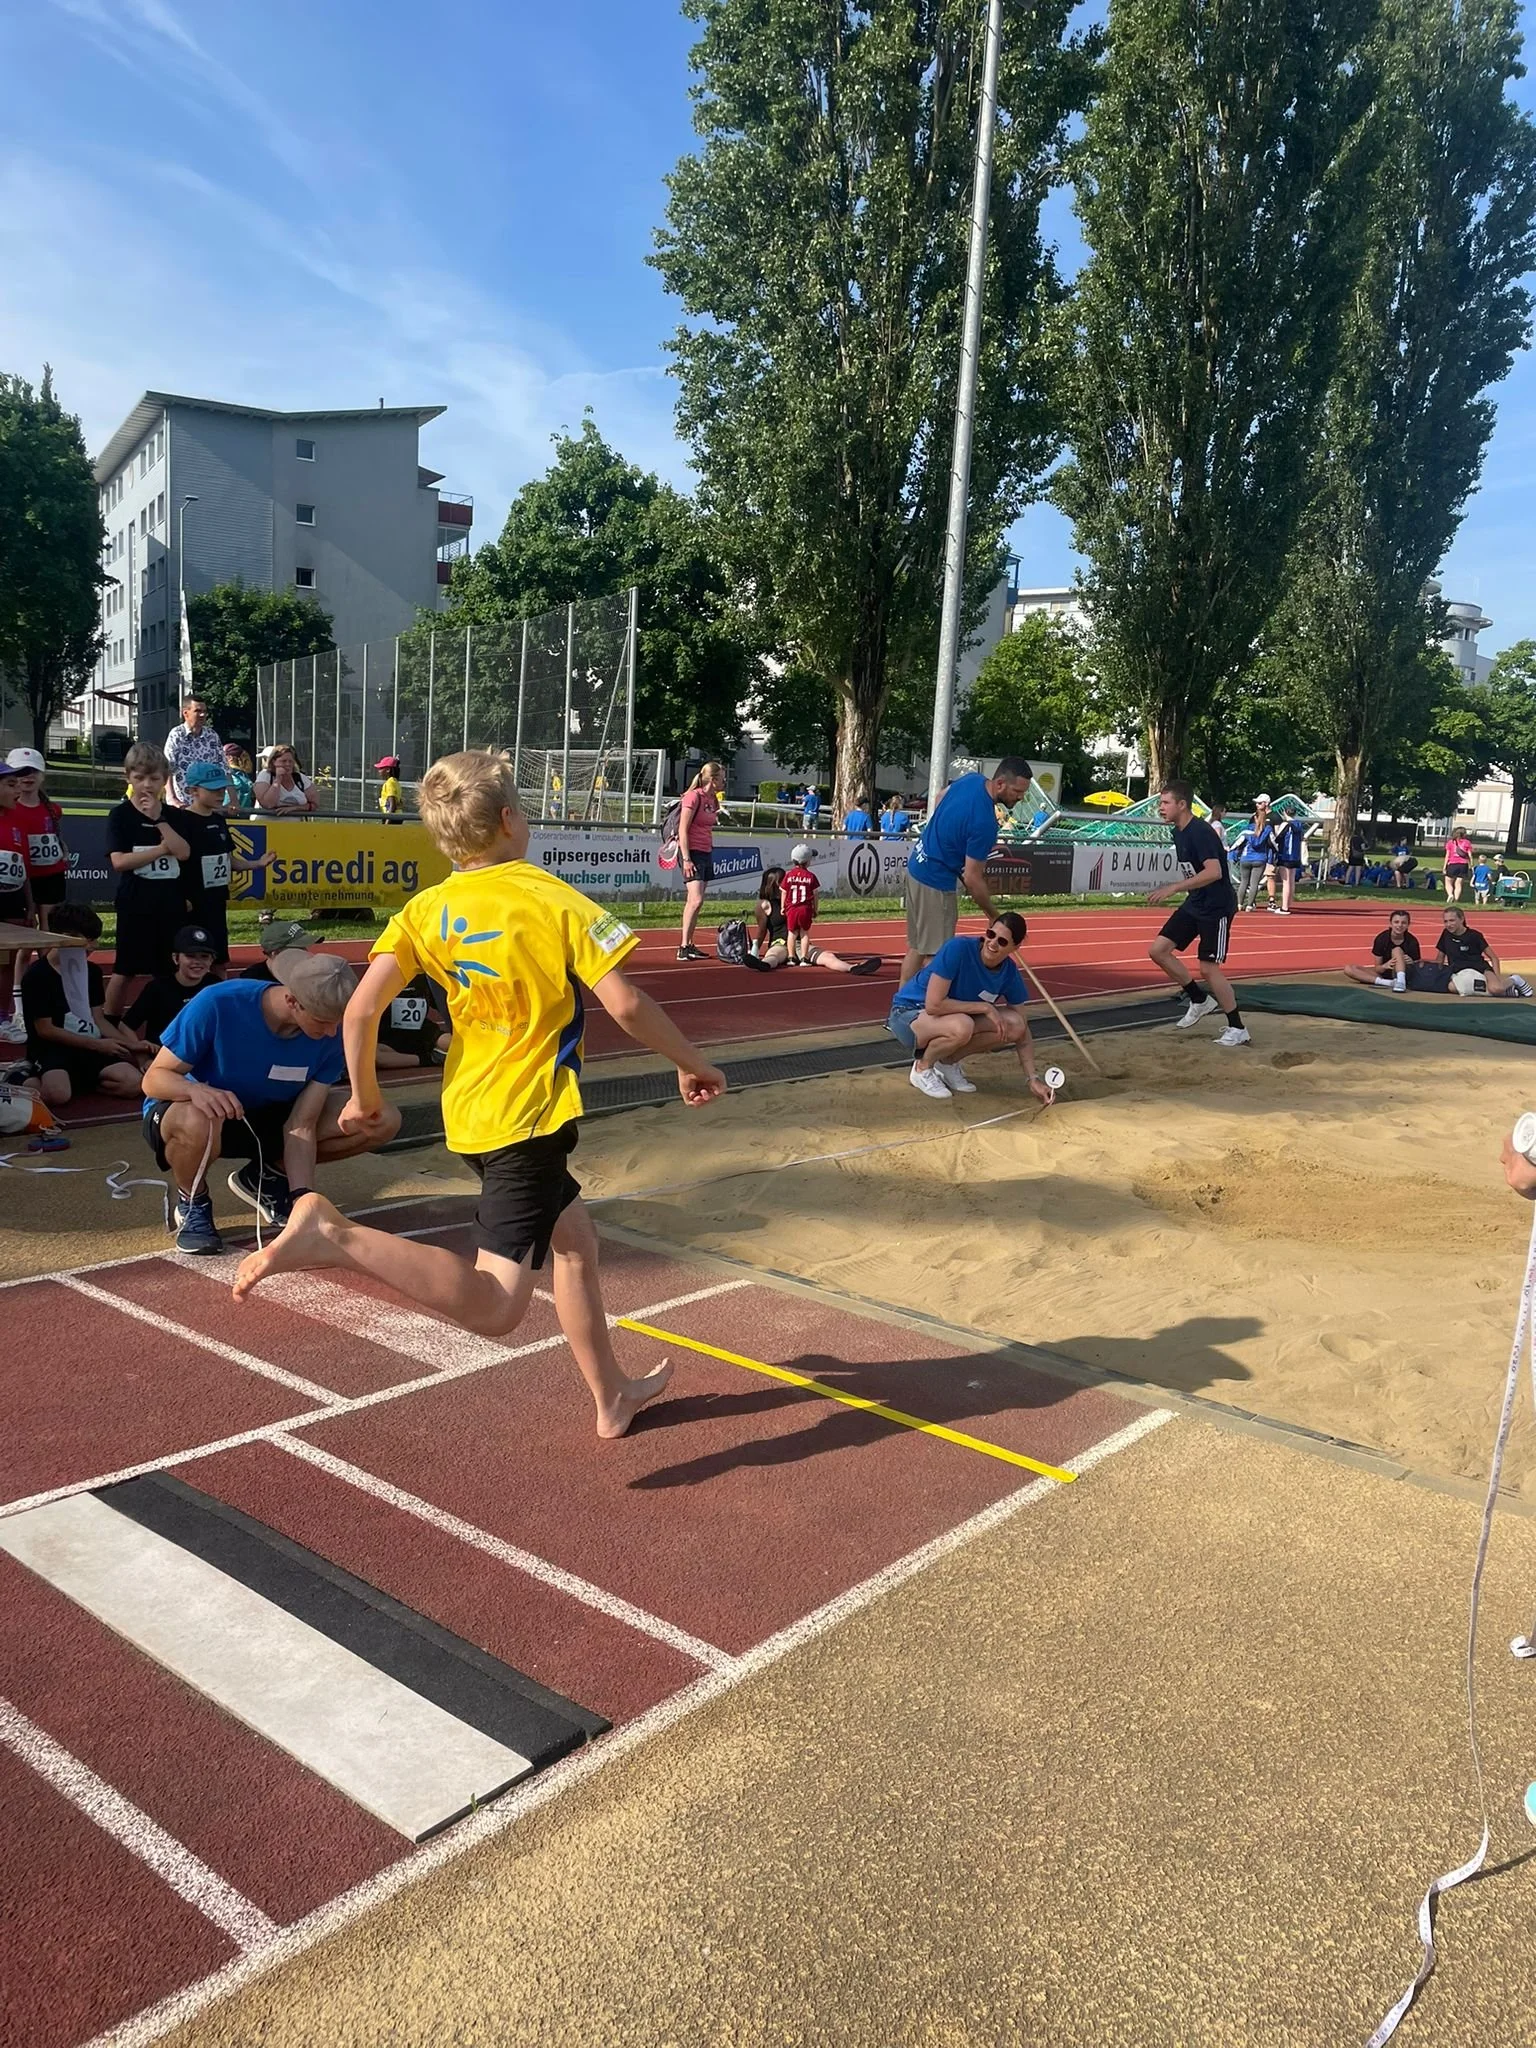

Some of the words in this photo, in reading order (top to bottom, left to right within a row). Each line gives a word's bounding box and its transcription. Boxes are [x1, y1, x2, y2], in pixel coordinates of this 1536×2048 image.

[30, 844, 60, 859] 208
[543, 847, 651, 866] gipsergeschäft
[0, 862, 24, 878] 209
[271, 850, 375, 884] saredi
[382, 859, 419, 892] ag
[713, 853, 759, 875] bächerli
[64, 869, 109, 880] MATION
[213, 865, 228, 879] 22
[614, 869, 651, 888] gmbh
[790, 884, 807, 905] 11
[401, 1009, 421, 1022] 20
[77, 1019, 94, 1034] 21
[1051, 1070, 1060, 1083] 7
